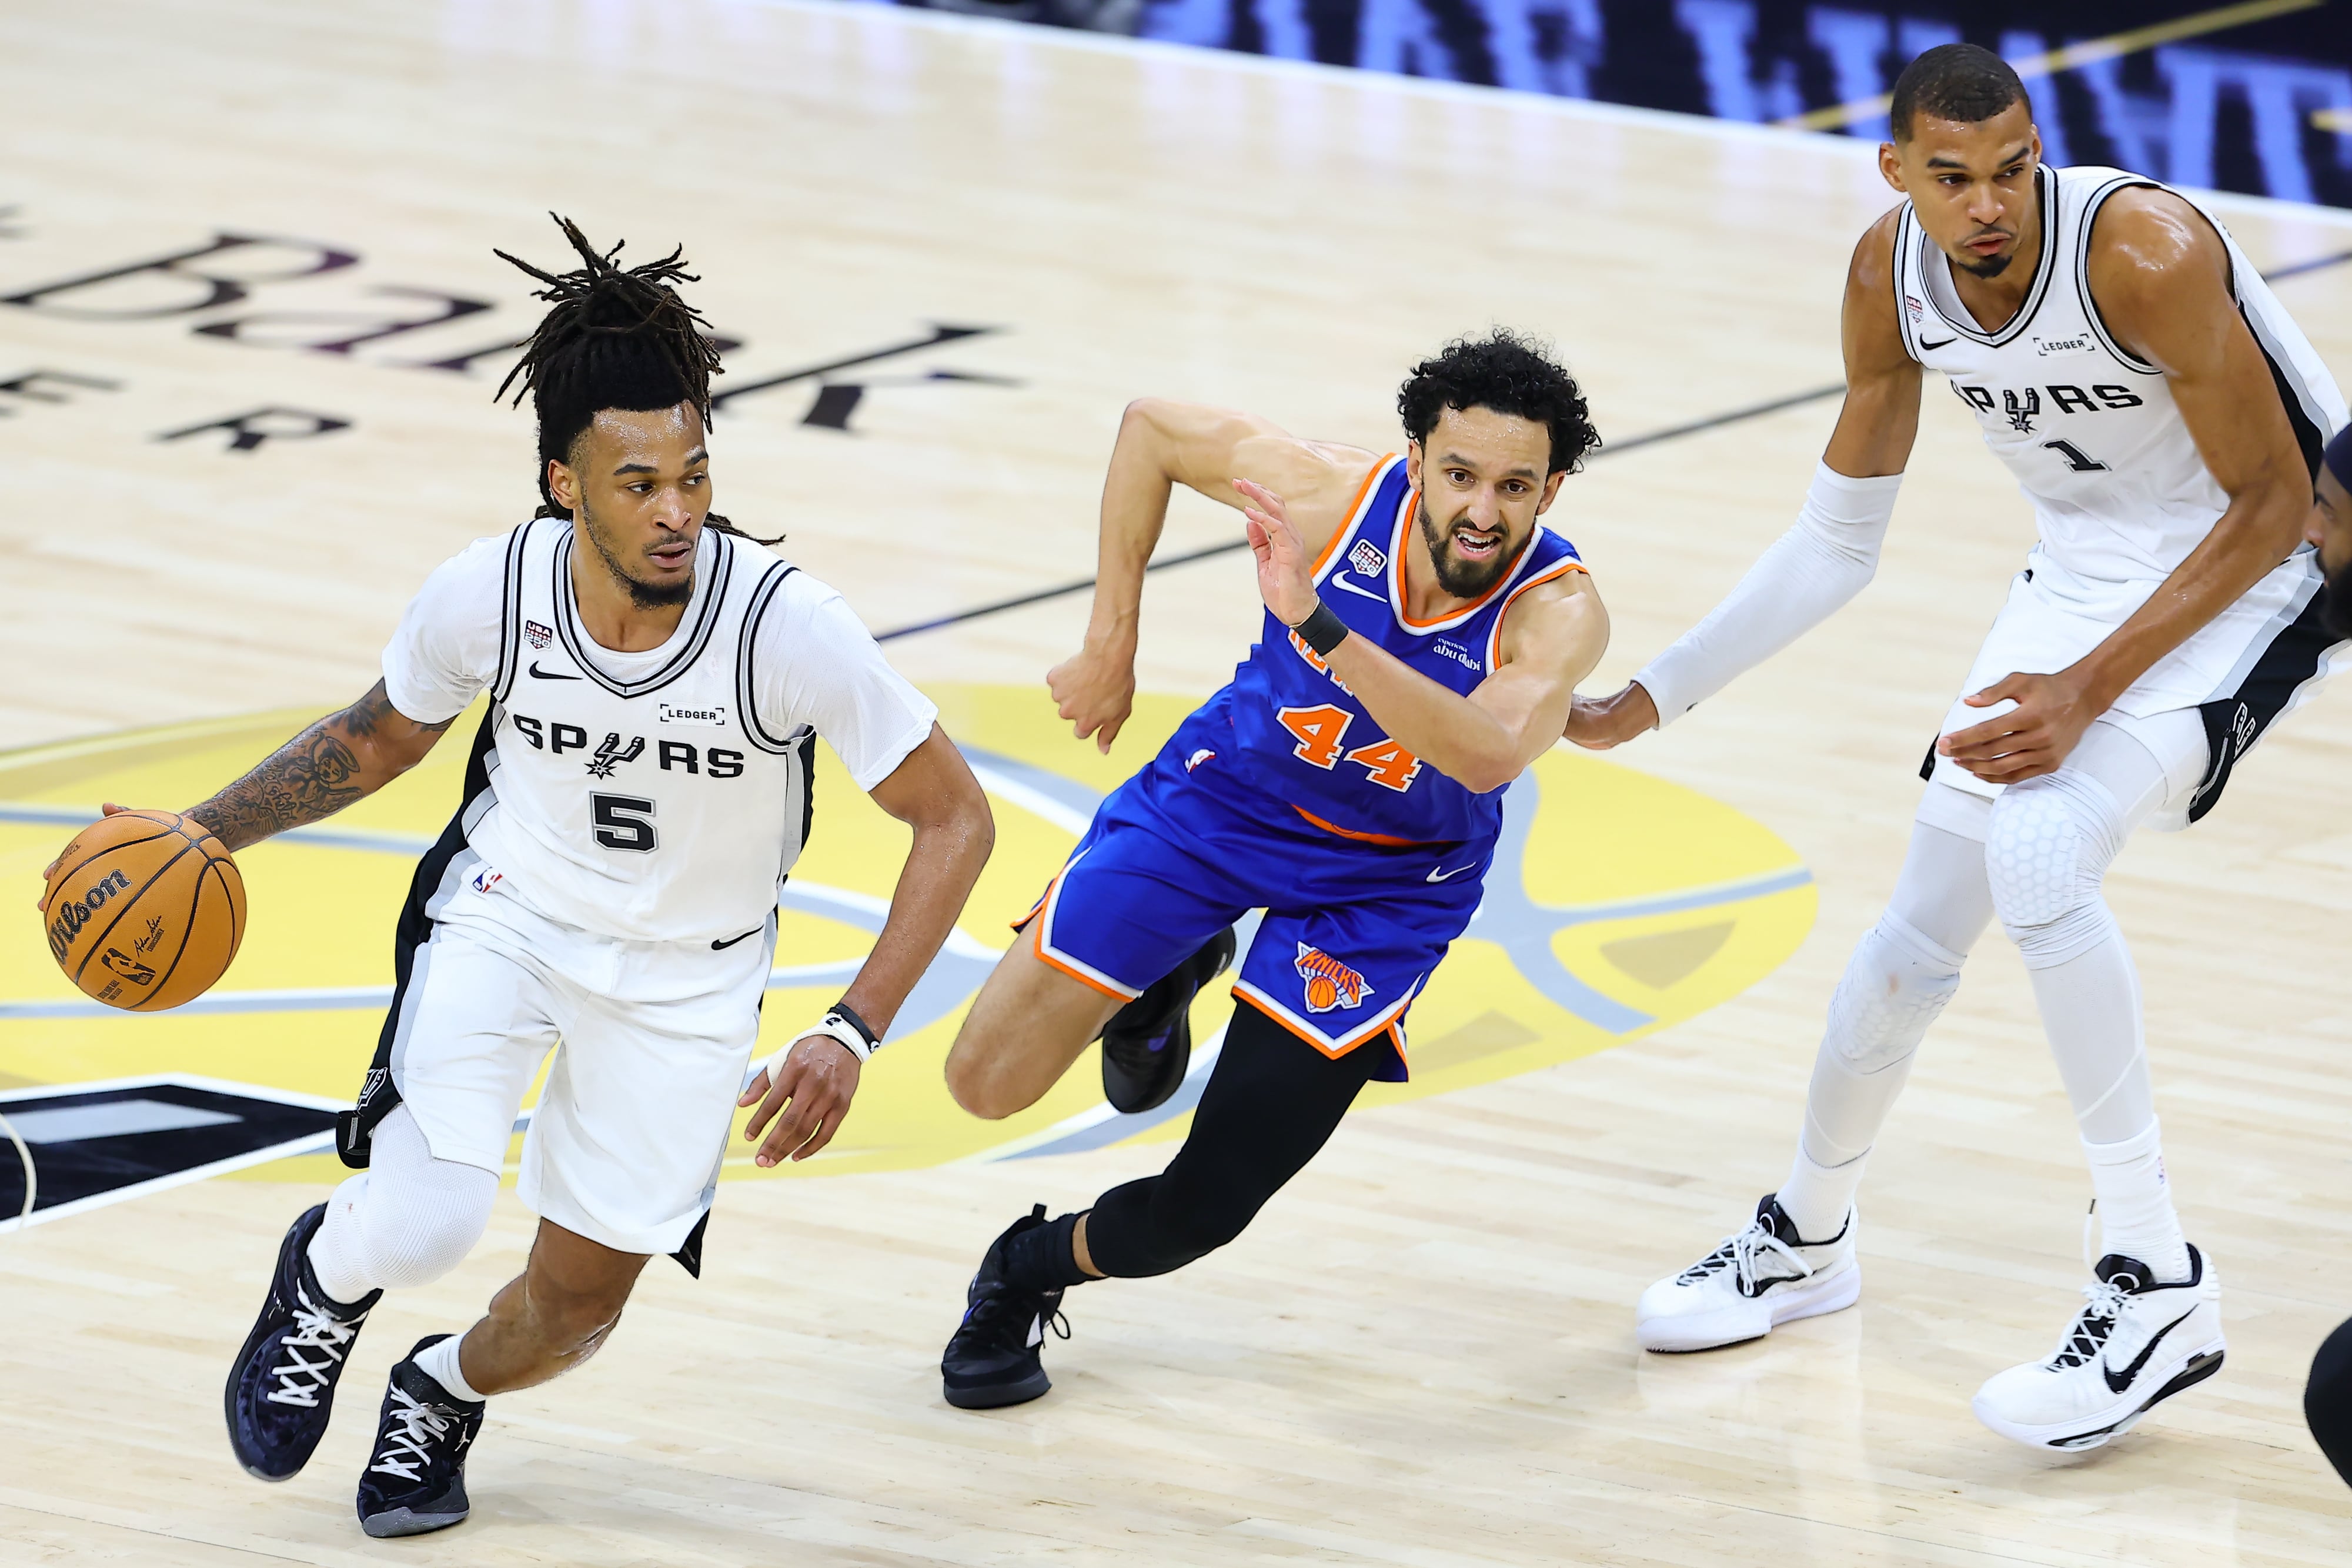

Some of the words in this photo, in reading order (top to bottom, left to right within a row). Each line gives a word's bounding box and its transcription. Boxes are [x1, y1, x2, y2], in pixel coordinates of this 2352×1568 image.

[2042, 340, 2086, 351] LEDGER
[2039, 438, 2113, 474] 1
[1351, 552, 1377, 574] 250
[1360, 543, 1381, 565] USA
[524, 632, 551, 648] 250
[527, 622, 551, 637] USA
[1437, 637, 1468, 653] experience
[1433, 644, 1458, 660] abu
[1458, 653, 1481, 671] dhabi
[668, 709, 716, 720] LEDGER
[1275, 703, 1423, 794] 44
[589, 790, 660, 855] 5
[1297, 948, 1362, 1005] KNICKS
